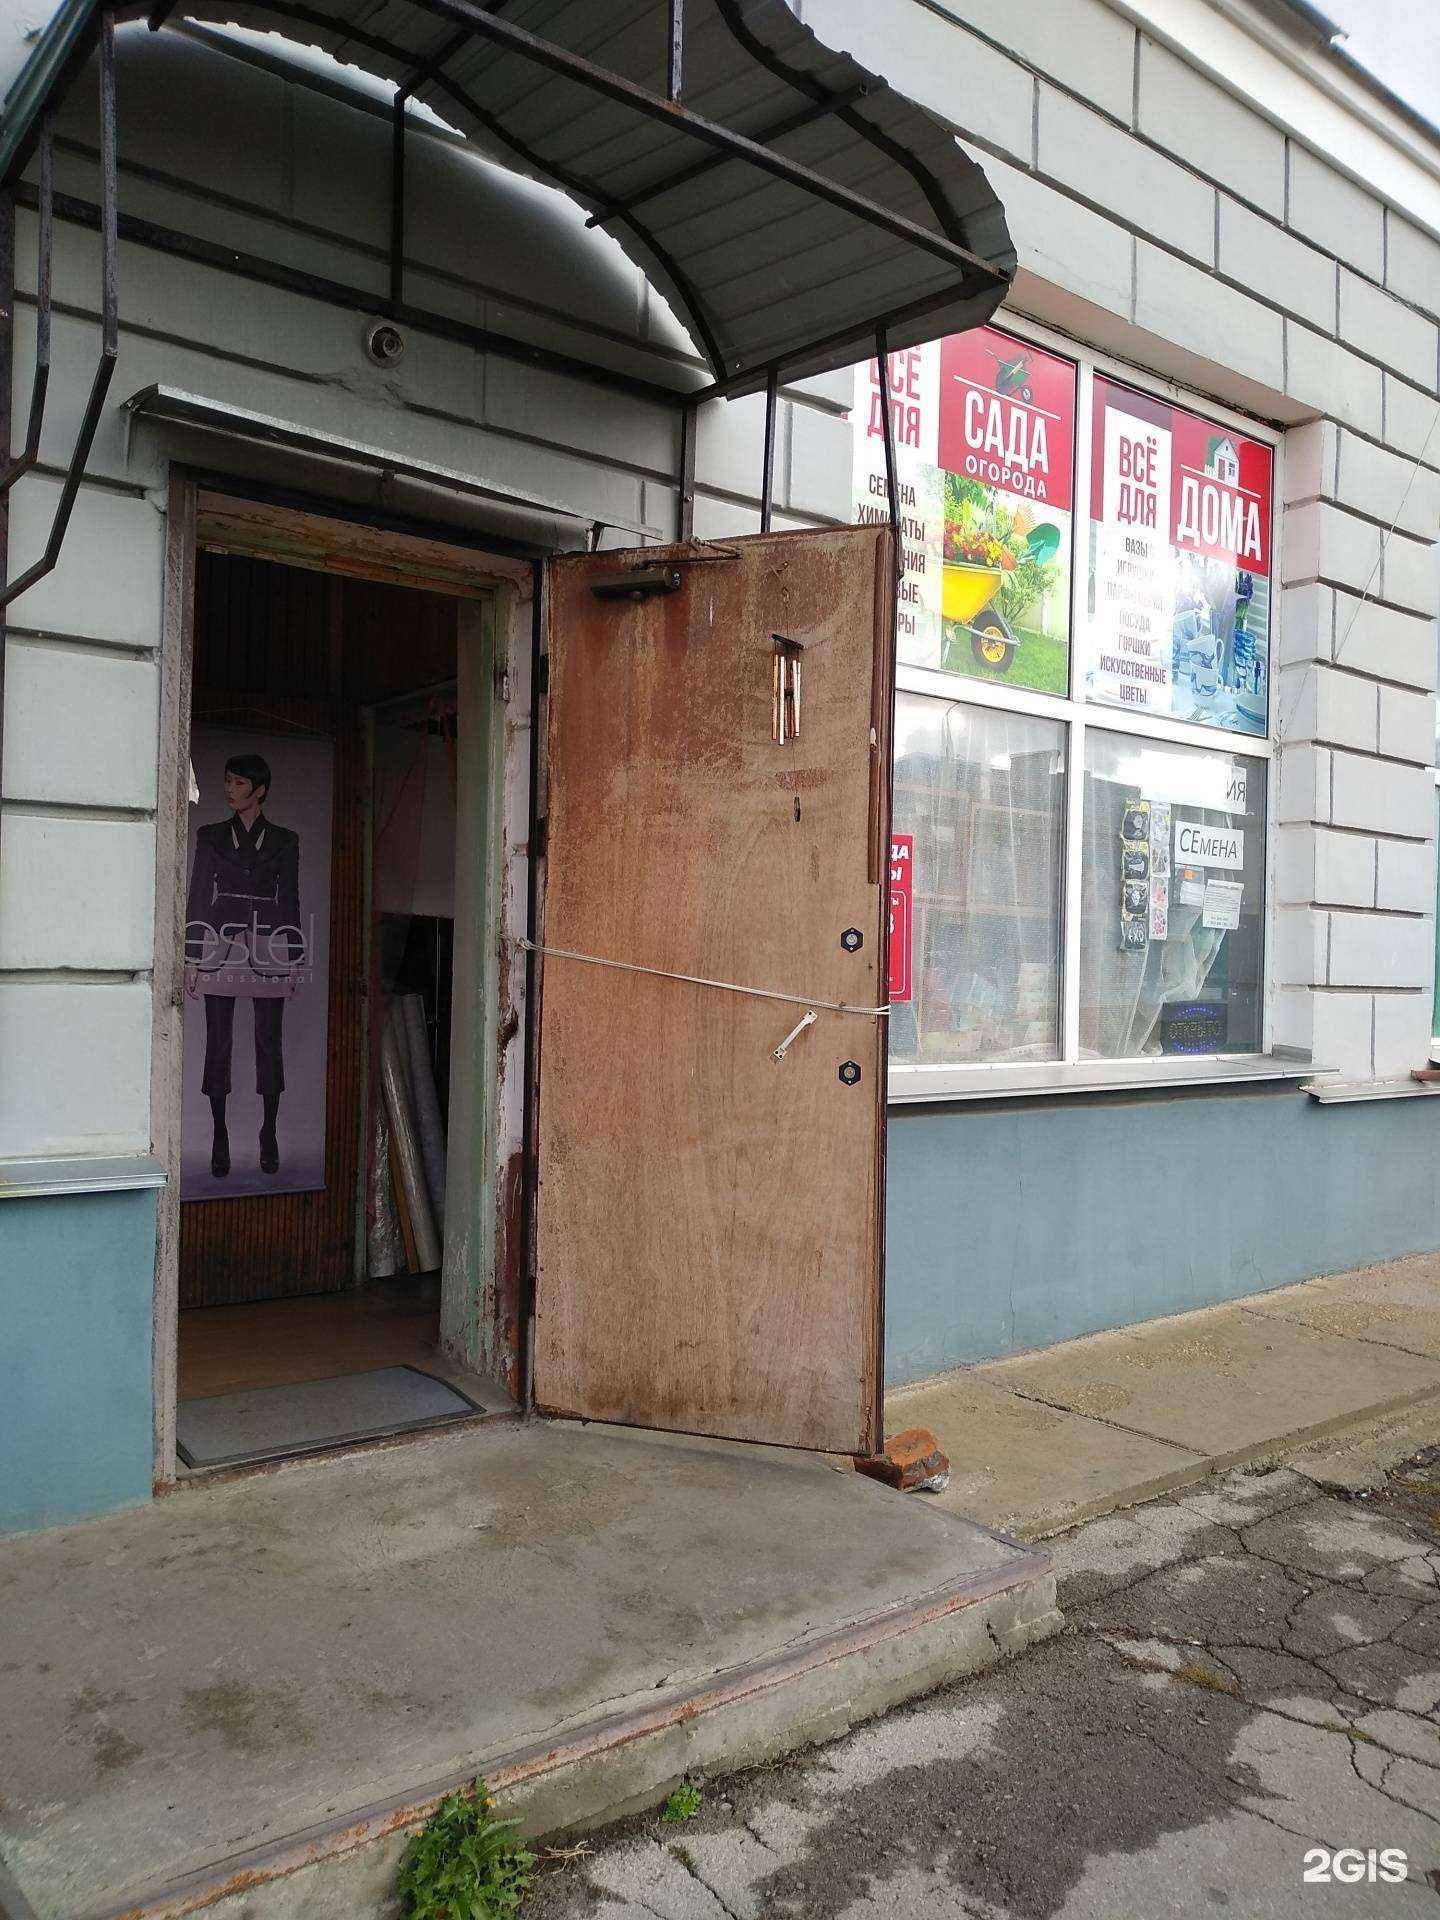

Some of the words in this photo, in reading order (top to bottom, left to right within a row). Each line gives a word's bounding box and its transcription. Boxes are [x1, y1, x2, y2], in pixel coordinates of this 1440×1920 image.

[965, 391, 1049, 474] САДА
[965, 455, 1048, 499] ОГОРОДА
[1119, 435, 1157, 489] ВСЁ
[1117, 482, 1157, 529] ДЛЯ
[1177, 474, 1263, 562] ДОМА
[1125, 537, 1149, 558] ВАЗЫ
[1119, 608, 1151, 633] ПОСУДА
[1118, 634, 1151, 657] ГОРШКИ
[1100, 654, 1167, 685] ИСКУССТВЕННЫЕ
[1120, 683, 1148, 704] ЦВЕТЫ
[1180, 828, 1238, 859] СЕМЕНА
[185, 910, 315, 967] estel
[190, 971, 314, 984] rofessional
